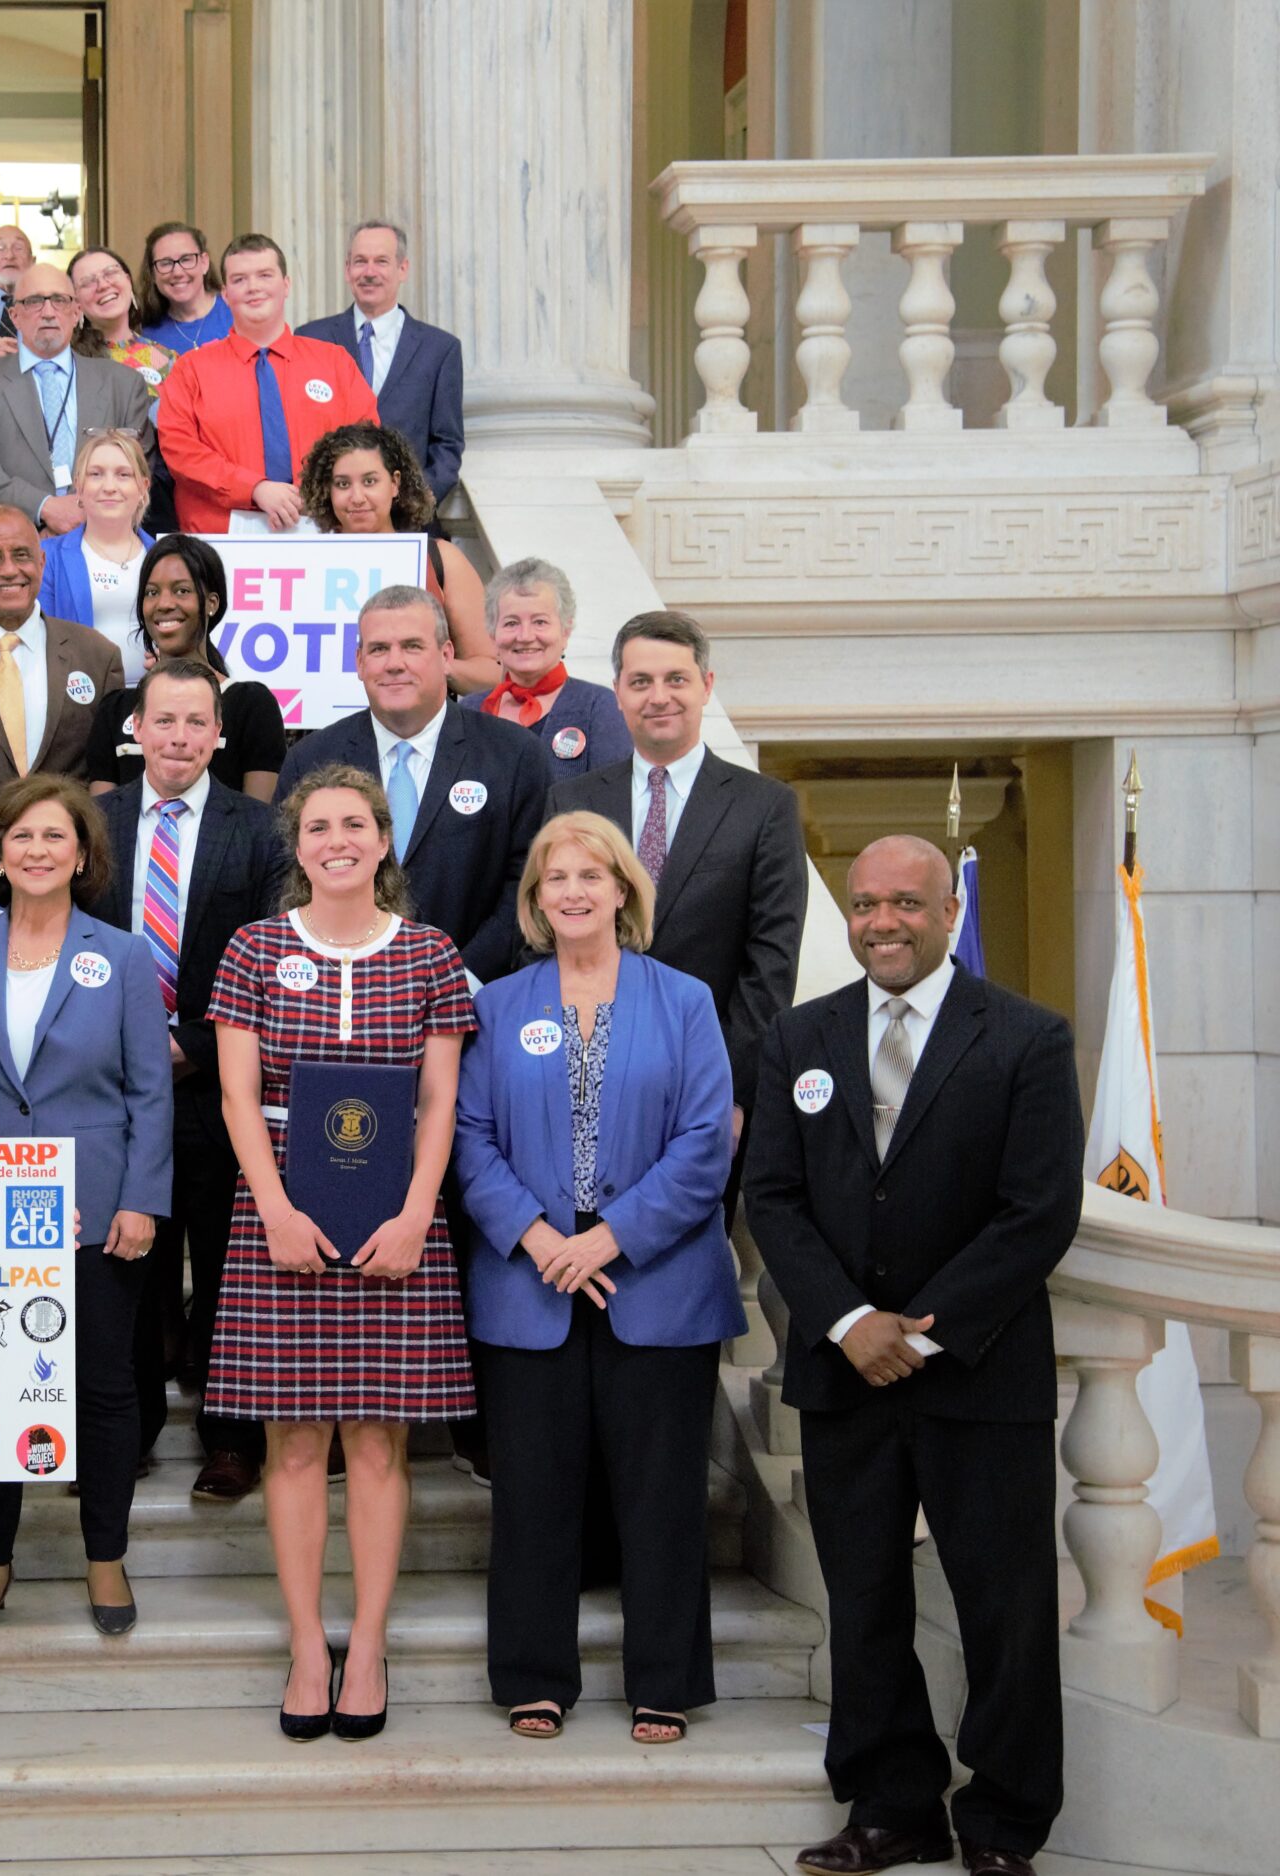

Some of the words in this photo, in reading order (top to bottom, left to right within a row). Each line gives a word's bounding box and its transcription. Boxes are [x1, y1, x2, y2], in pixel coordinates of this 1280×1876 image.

[94, 576, 118, 584] VOTE
[232, 568, 306, 612] ET
[68, 684, 92, 696] VOTE
[454, 786, 471, 794] LET
[454, 795, 484, 804] VOTE
[76, 954, 96, 968] LET
[75, 963, 106, 981] VOTE
[280, 970, 314, 980] VOTE
[524, 1028, 543, 1036] LET
[524, 1034, 558, 1046] VOTE
[798, 1080, 817, 1089] LET
[798, 1088, 829, 1100] VOTE
[16, 1167, 56, 1178] Island
[12, 1190, 57, 1199] RHODE
[12, 1199, 57, 1208] ISLAND
[11, 1208, 58, 1226] AFL
[10, 1226, 60, 1246] CIO
[19, 1388, 68, 1402] ARISE
[28, 1452, 56, 1464] PROJECT
